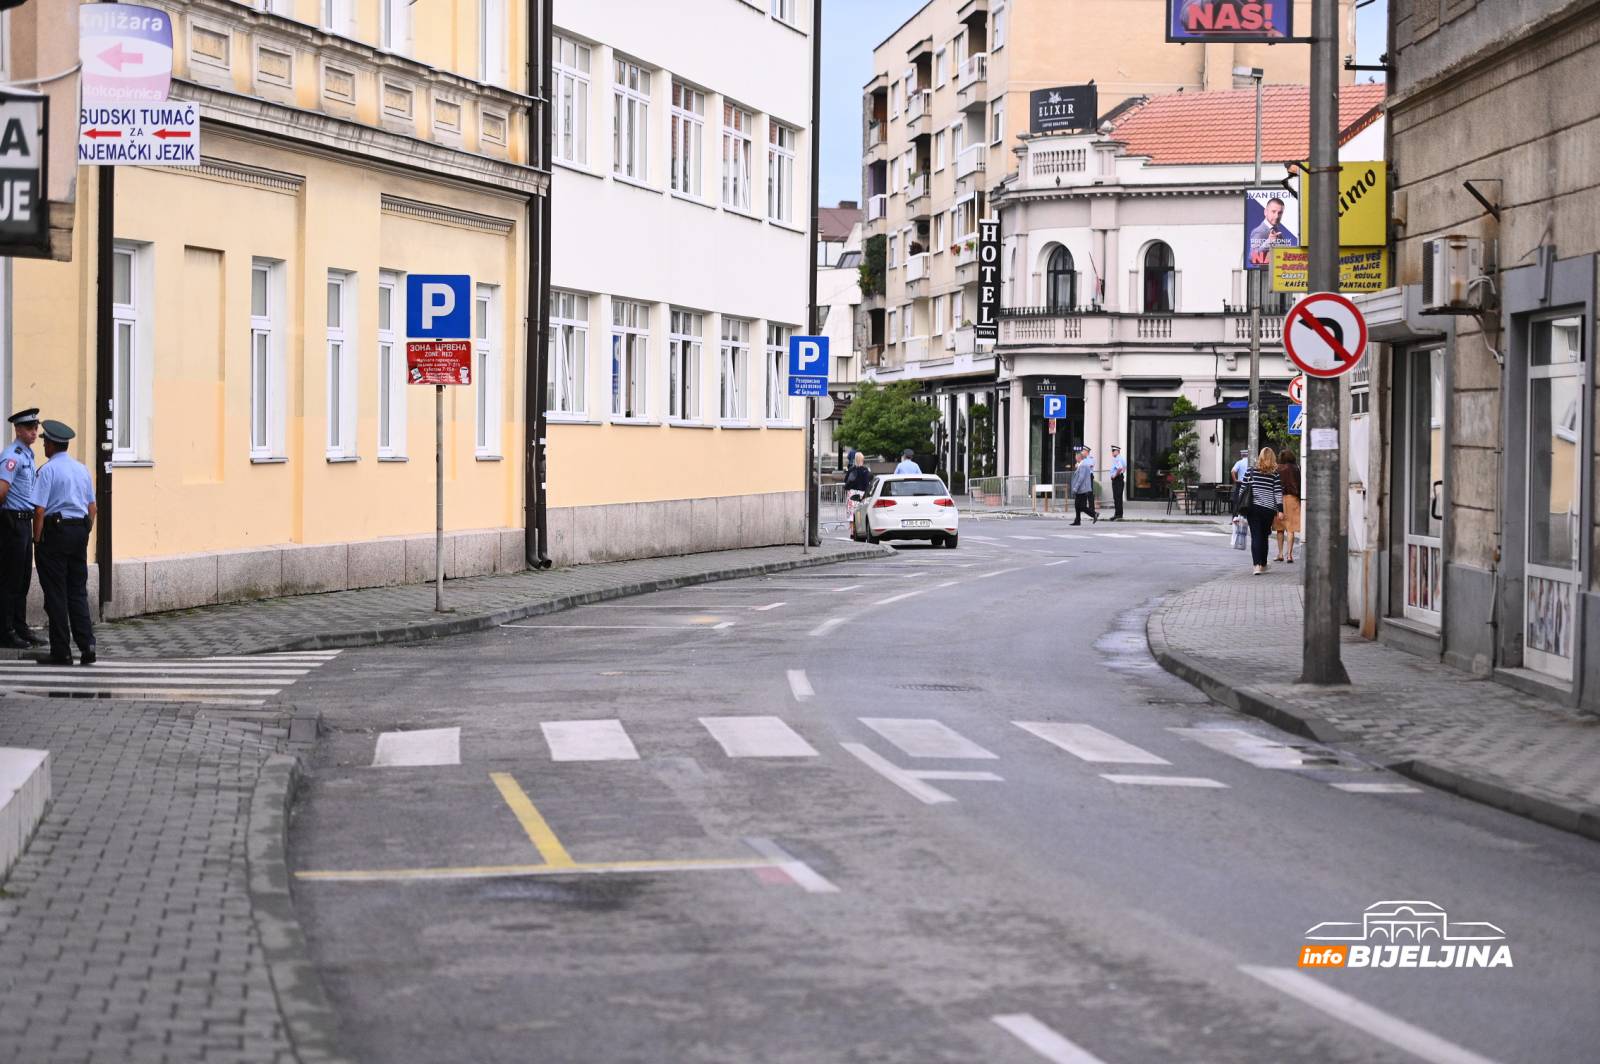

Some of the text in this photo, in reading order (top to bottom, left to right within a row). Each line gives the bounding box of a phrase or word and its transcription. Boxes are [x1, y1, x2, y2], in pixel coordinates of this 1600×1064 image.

[81, 106, 195, 125] SUDSKI TUMAČ
[1039, 104, 1074, 117] ELIXIR
[130, 128, 144, 136] ZA
[79, 141, 195, 160] NJEMAČKI JEZIK
[1247, 191, 1268, 200] IVAN
[1338, 169, 1376, 218] imo
[981, 224, 997, 325] HOTEL
[1352, 261, 1381, 272] MAJICE
[1339, 281, 1383, 289] PANTALONE
[422, 283, 456, 330] P
[409, 343, 467, 352] ЗОНА ЦРВЕНА
[798, 341, 820, 371] P
[1049, 398, 1061, 415] P
